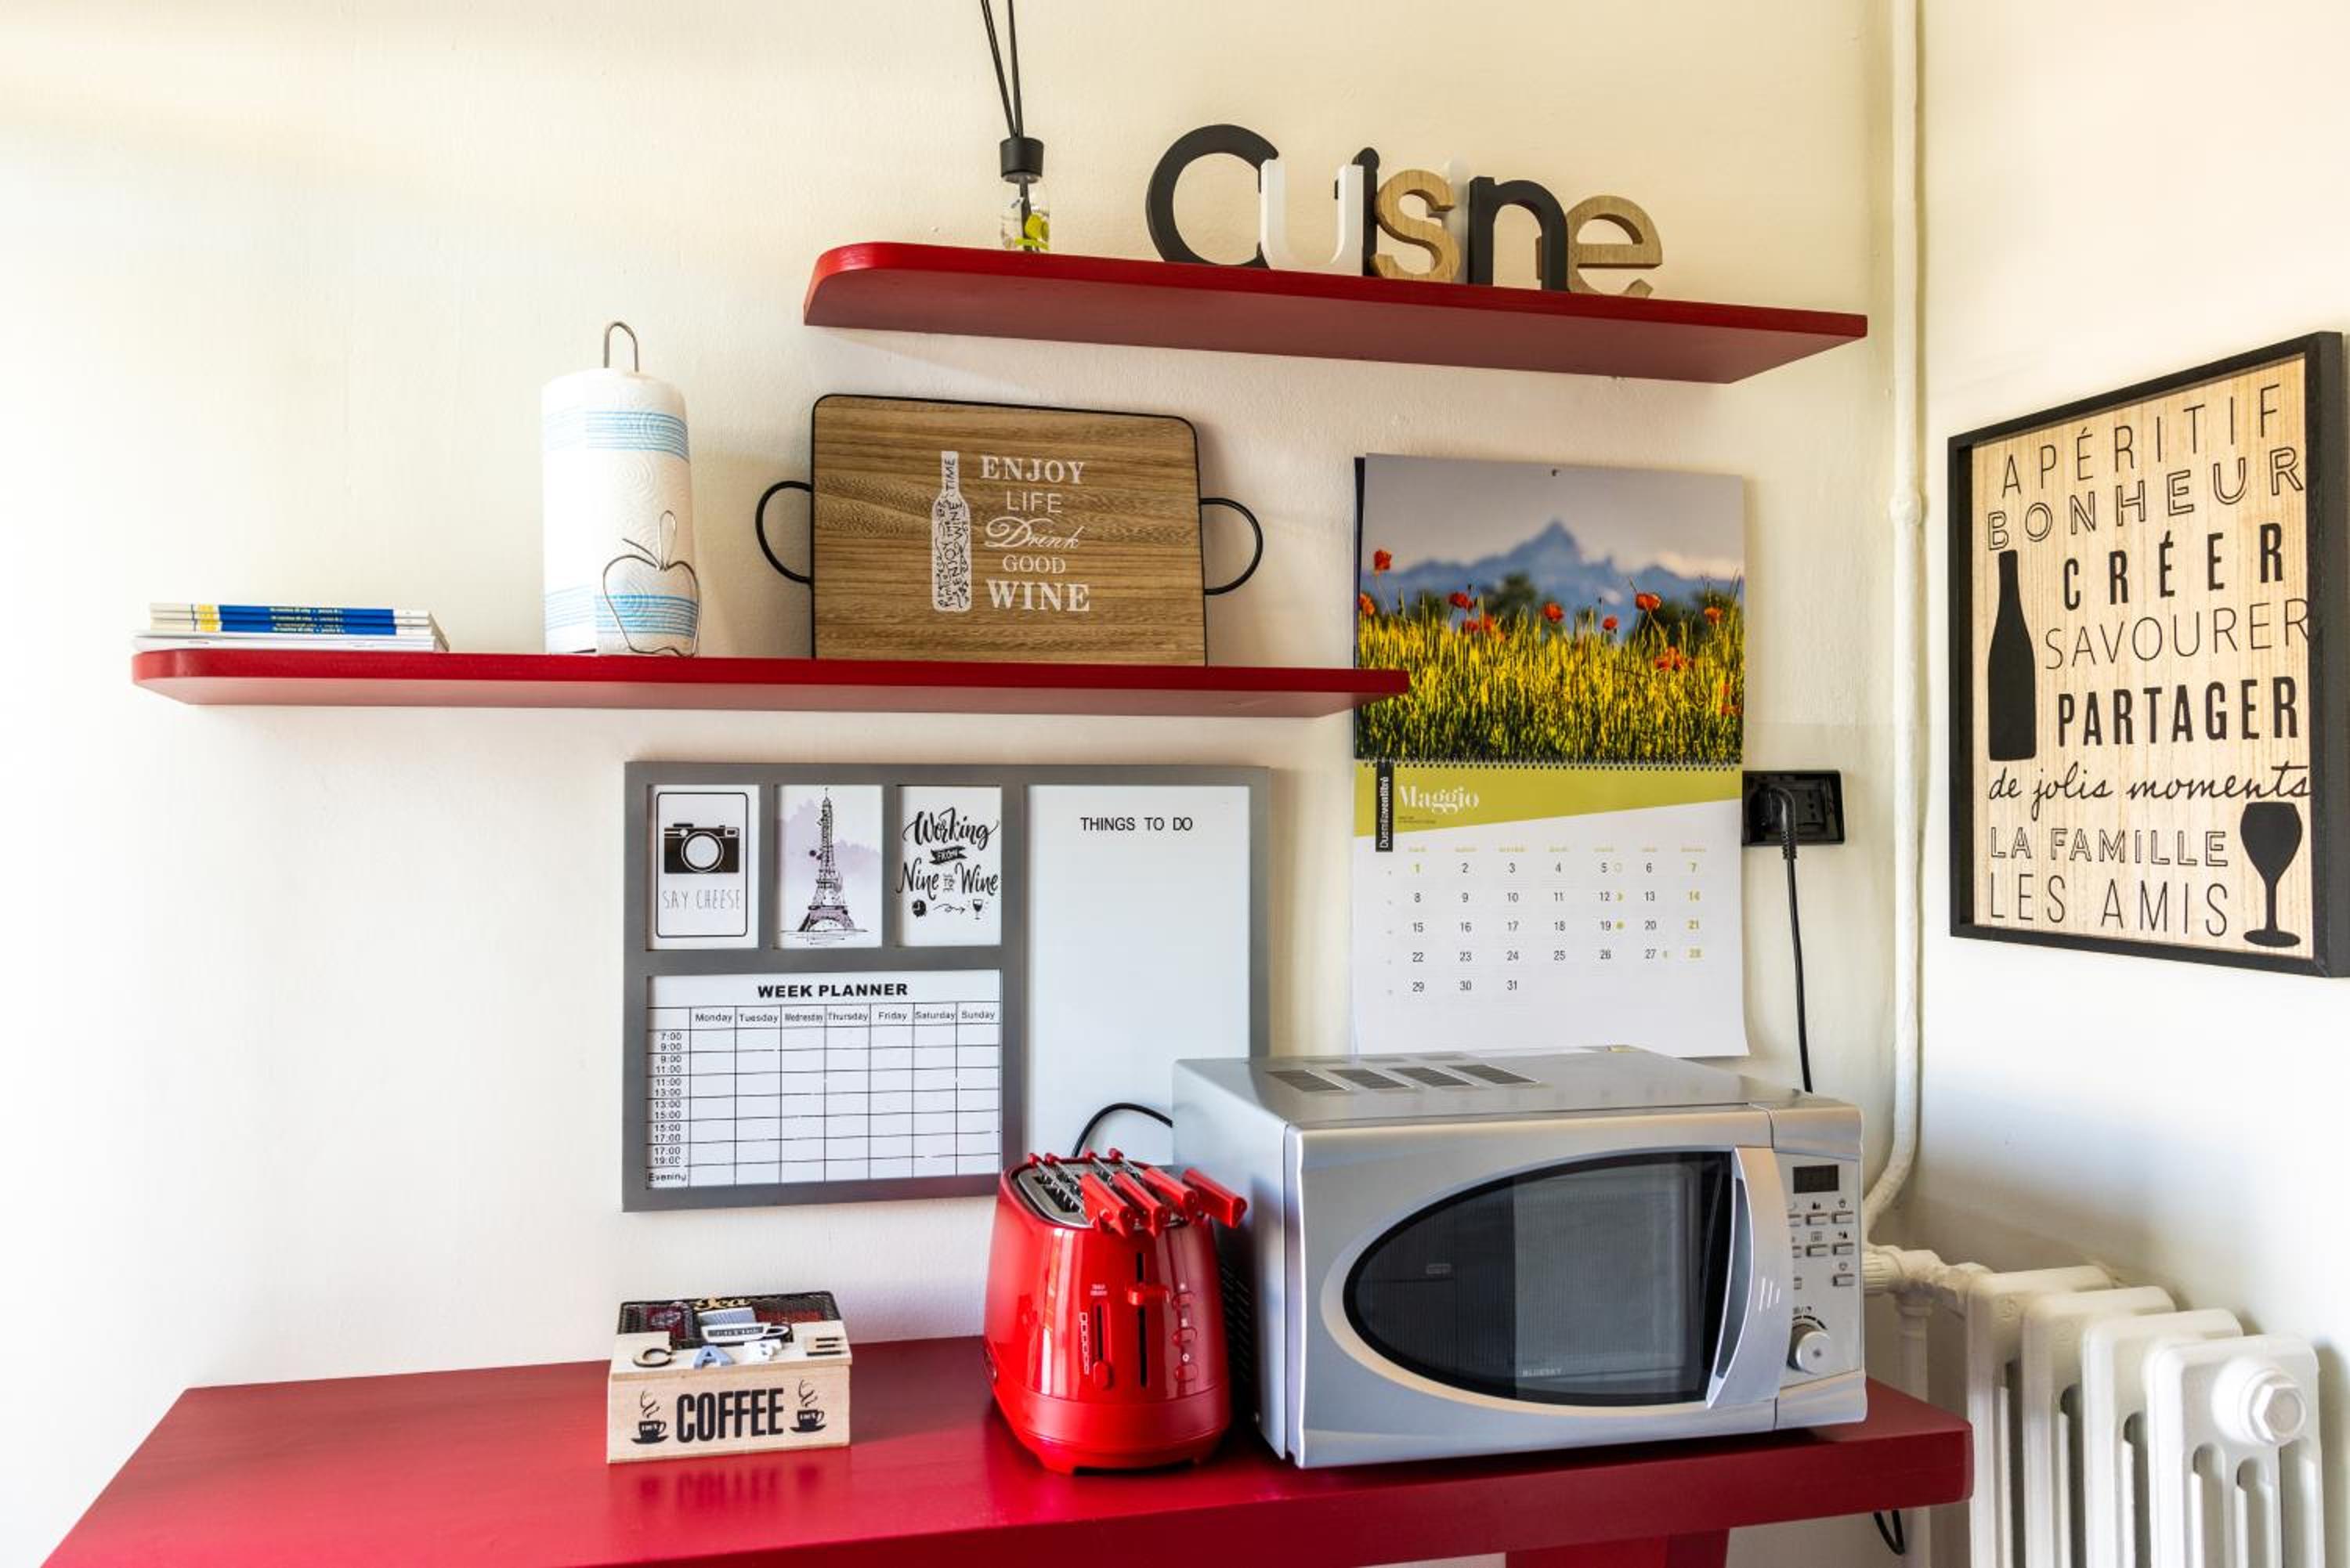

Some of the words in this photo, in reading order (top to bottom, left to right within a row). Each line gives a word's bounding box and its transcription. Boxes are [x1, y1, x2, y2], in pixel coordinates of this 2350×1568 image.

[2002, 384, 2280, 499] APÉRITIF
[981, 454, 1086, 485] ENJOY
[1007, 490, 1062, 514] LIFE
[1988, 446, 2304, 551] BONHEUR
[985, 516, 1085, 549] Drink
[1003, 555, 1066, 574] GOOD
[2063, 522, 2283, 611] CRÉER
[985, 579, 1090, 612] WINE
[2045, 598, 2308, 670] SAVOURER
[2058, 676, 2298, 747] PARTAGER
[1398, 786, 1480, 815] Maggio
[1990, 767, 2023, 800] de
[2031, 761, 2113, 821] jolis
[2127, 761, 2312, 800] moments
[902, 807, 1000, 851] Working
[1079, 817, 1135, 831] THINGS
[1144, 817, 1165, 831] TO
[1173, 817, 1193, 831] DO
[1990, 827, 2032, 859] LA
[2051, 829, 2229, 866] FAMILLE
[896, 857, 939, 901] Nine
[954, 862, 999, 896] Wine
[1462, 863, 1469, 873] 2
[1509, 863, 1516, 873] 3
[1555, 862, 1562, 873] 4
[1601, 862, 1607, 873] 5
[1646, 862, 1652, 873] 6
[662, 890, 689, 909] SAY
[696, 890, 740, 909] CHEESE
[1414, 892, 1421, 902] 8
[1462, 892, 1469, 902] 9
[1507, 892, 1519, 902] 10
[1554, 892, 1564, 901] 11
[1599, 891, 1611, 901] 12
[1645, 891, 1655, 901] 13
[1990, 872, 2066, 923] LES
[2101, 879, 2229, 937] AMIS
[1412, 922, 1423, 933] 15
[1460, 922, 1472, 932] 16
[1507, 921, 1519, 931] 17
[1554, 921, 1566, 931] 18
[1600, 920, 1611, 930] 19
[1645, 920, 1657, 930] 20
[1412, 952, 1424, 963] 22
[1459, 952, 1472, 962] 23
[1506, 950, 1519, 961] 24
[1554, 950, 1566, 960] 25
[1600, 949, 1611, 959] 26
[1645, 949, 1657, 959] 27
[757, 984, 813, 999] WEEK
[819, 983, 909, 997] PLANNER
[1412, 981, 1425, 992] 29
[1459, 981, 1472, 991] 30
[1506, 980, 1518, 990] 31
[695, 1014, 732, 1024] Monday
[739, 1013, 778, 1024] Tuesday
[827, 1012, 868, 1022] Thursday
[878, 1010, 908, 1021] Friday
[915, 1010, 956, 1021] Saturday
[961, 1010, 996, 1021] Sunday
[677, 1388, 784, 1443] COFFEE
